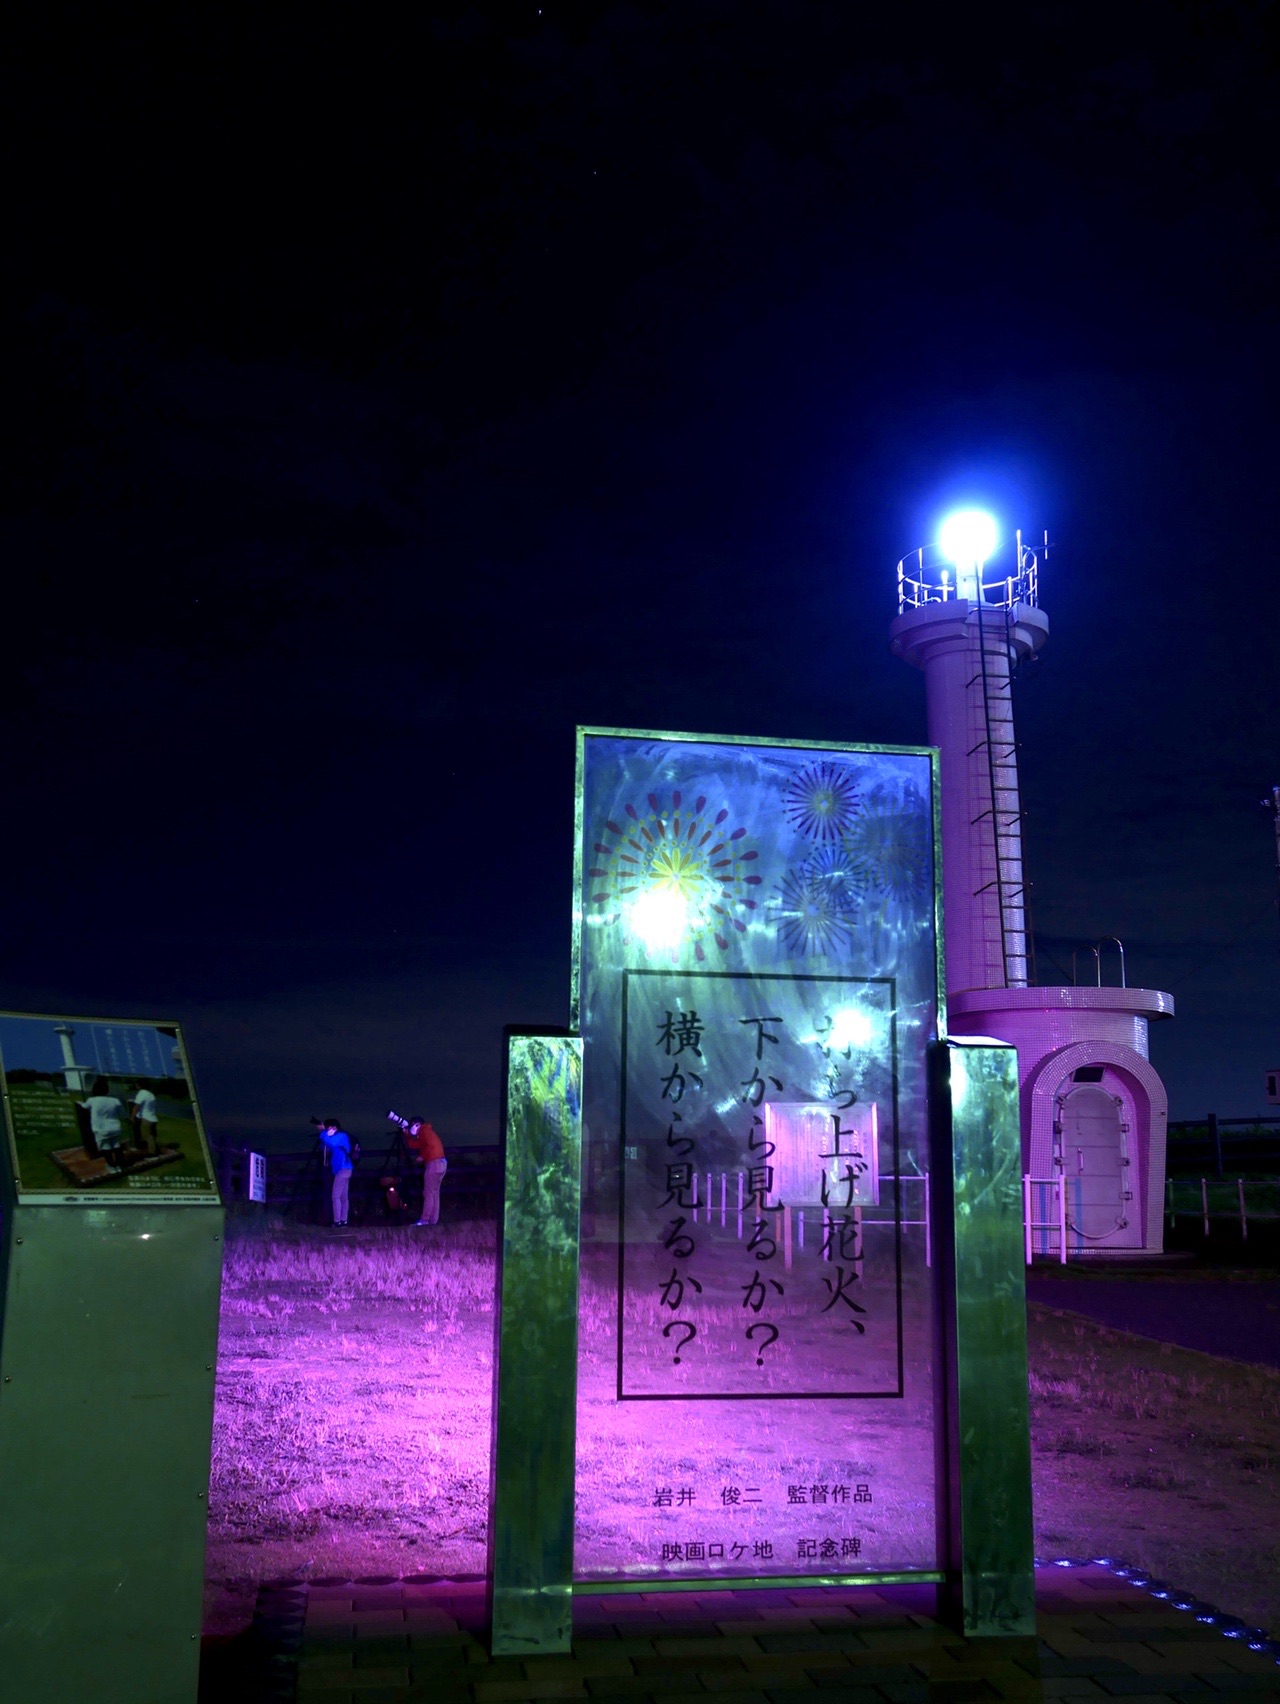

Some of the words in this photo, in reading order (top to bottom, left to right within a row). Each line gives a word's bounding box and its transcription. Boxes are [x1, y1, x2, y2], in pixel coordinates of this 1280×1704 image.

[657, 1010, 704, 1365] 横から見るか？
[740, 1016, 784, 1366] 下から見るか？
[653, 1488, 697, 1507] 岩井
[721, 1486, 763, 1506] 俊二
[787, 1484, 873, 1505] 監督作品
[661, 1540, 774, 1562] 映画ロケ地
[797, 1537, 862, 1558] 記念碑
